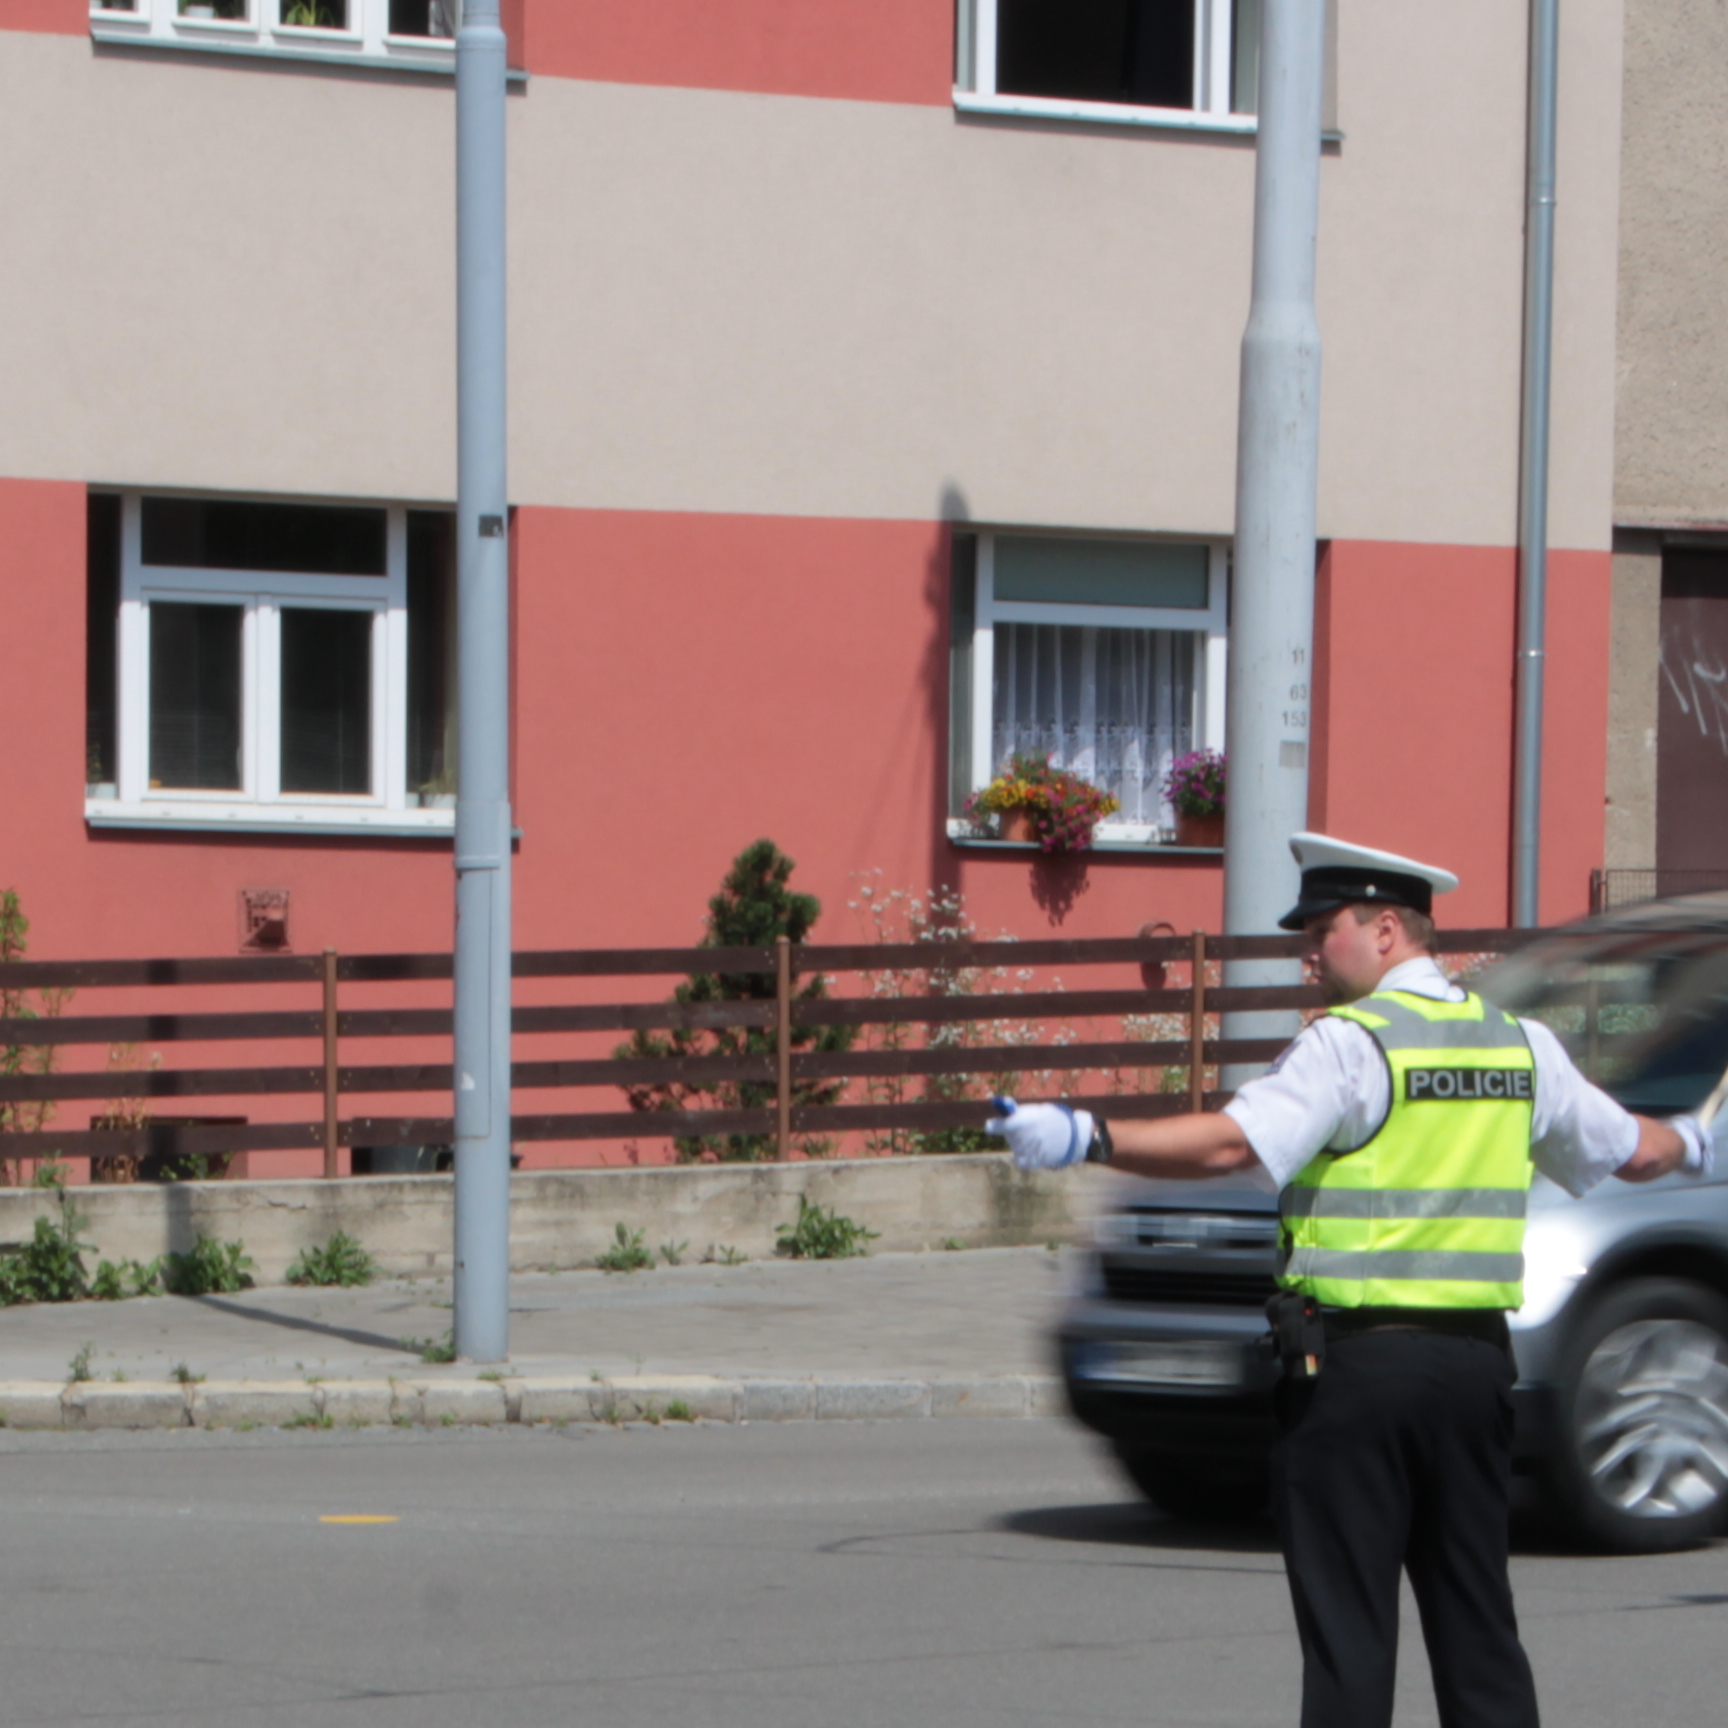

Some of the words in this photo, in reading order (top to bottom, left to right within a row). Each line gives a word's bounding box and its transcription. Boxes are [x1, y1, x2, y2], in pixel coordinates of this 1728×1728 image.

[1289, 683, 1308, 701] 63
[1281, 710, 1308, 728] 153
[1408, 1069, 1532, 1098] POLICIE
